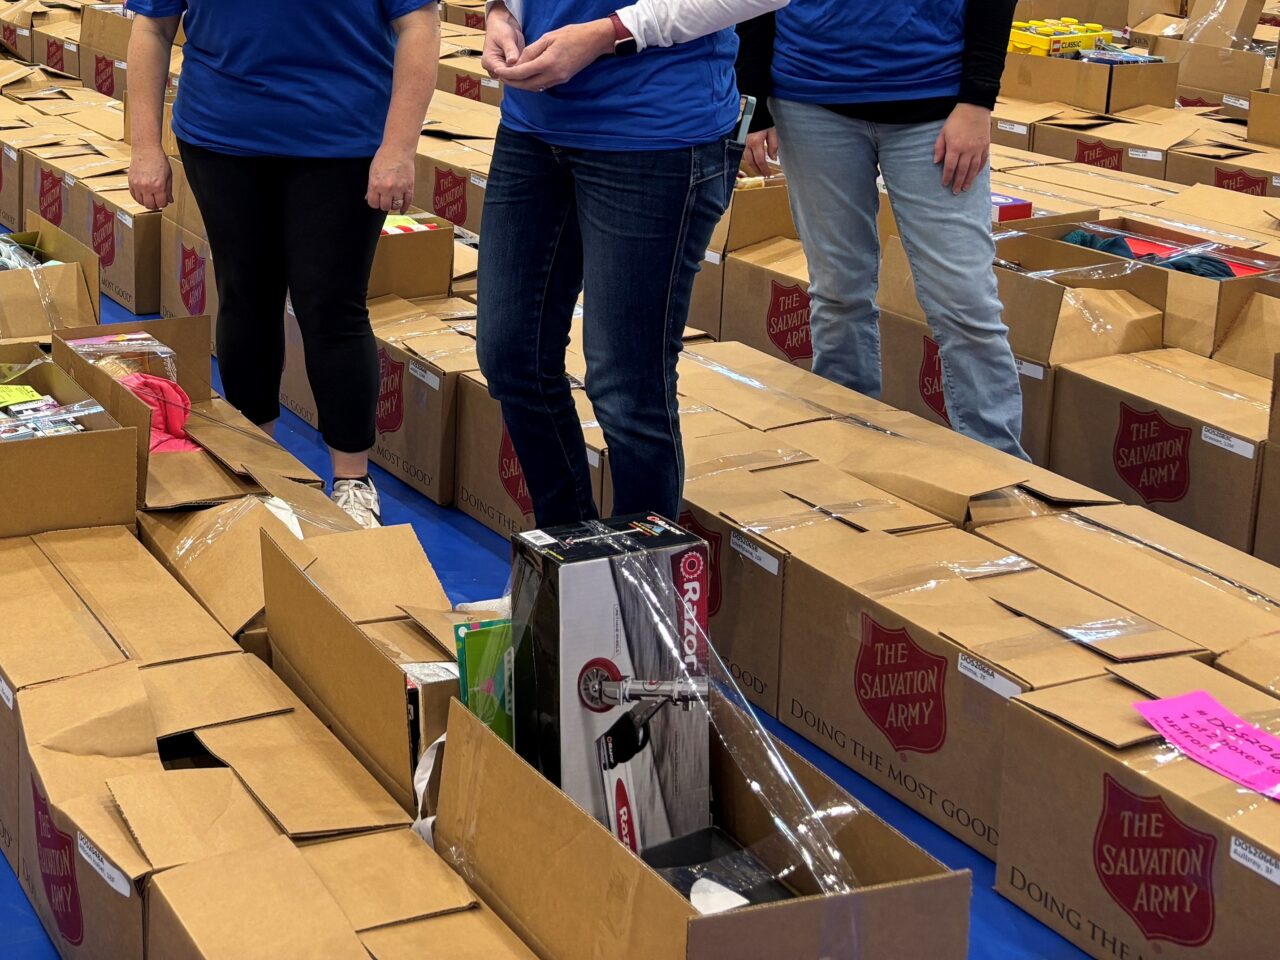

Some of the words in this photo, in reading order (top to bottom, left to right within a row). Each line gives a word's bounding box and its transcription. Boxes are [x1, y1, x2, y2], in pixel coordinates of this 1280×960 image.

[1062, 41, 1081, 49] CLASSIC
[1084, 148, 1103, 162] THE
[1223, 176, 1244, 190] THE
[40, 189, 60, 210] SALVATION
[46, 203, 59, 219] ARMY
[93, 225, 113, 247] SALVATION
[100, 241, 112, 259] ARMY
[185, 256, 196, 272] THE
[181, 264, 205, 293] SALVATION
[188, 284, 203, 307] ARMY
[779, 294, 800, 311] THE
[1130, 421, 1159, 440] THE
[377, 447, 400, 467] MOST
[1118, 436, 1184, 468] SALVATION
[1138, 461, 1180, 488] ARMY
[459, 486, 494, 518] DOING
[495, 509, 518, 530] THE
[683, 581, 700, 671] Razor
[874, 643, 909, 666] THE
[860, 666, 939, 700] SALVATION
[885, 699, 934, 732] ARMY
[1163, 716, 1218, 754] upfront
[1189, 722, 1208, 732] of
[1219, 740, 1265, 766] boxes
[790, 698, 847, 748] DOING
[849, 739, 883, 772] THE
[888, 765, 938, 806] MOST
[941, 798, 1000, 846] GOOD
[38, 811, 51, 838] THE
[619, 806, 632, 851] Raz
[1120, 810, 1164, 838] THE
[38, 842, 71, 876] SALVATION
[1100, 844, 1204, 877] SALVATION
[50, 884, 71, 913] ARMY
[1132, 883, 1198, 919] ARMY
[1010, 866, 1081, 932] DOING
[1088, 919, 1130, 960] THE
